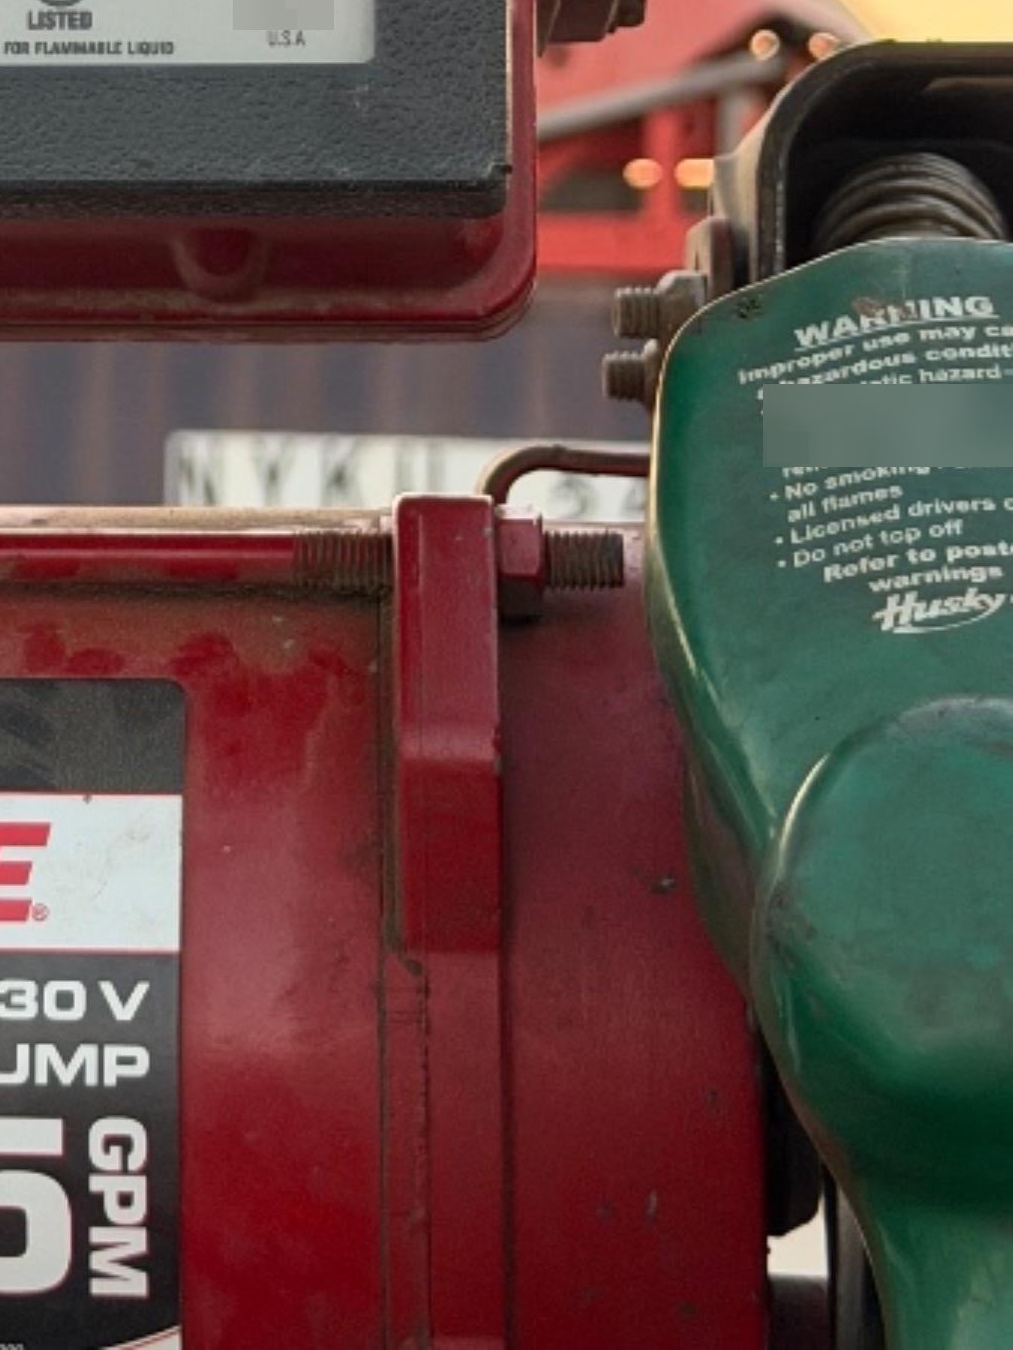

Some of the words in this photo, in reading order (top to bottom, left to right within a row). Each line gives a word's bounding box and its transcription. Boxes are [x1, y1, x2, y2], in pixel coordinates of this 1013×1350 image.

[28, 11, 92, 31] LISTED
[4, 41, 30, 56] FOR
[34, 41, 122, 56] FLAMMABLE
[127, 41, 175, 56] LIQUID
[794, 296, 996, 348] WARNING
[862, 331, 911, 352] use
[918, 326, 975, 342] may
[785, 481, 819, 500] No
[788, 502, 816, 523] all
[822, 485, 904, 512] flames
[791, 504, 901, 545] Licensed
[908, 498, 997, 517] drivers
[794, 548, 826, 568] Do
[833, 534, 874, 556] not
[880, 526, 922, 545] top
[929, 518, 964, 539] off
[824, 553, 900, 583] Refer
[906, 546, 937, 564] to
[868, 565, 1004, 592] warnings
[872, 586, 1007, 633] Husky
[99, 980, 150, 1022] V
[88, 1116, 149, 1298] GPM
